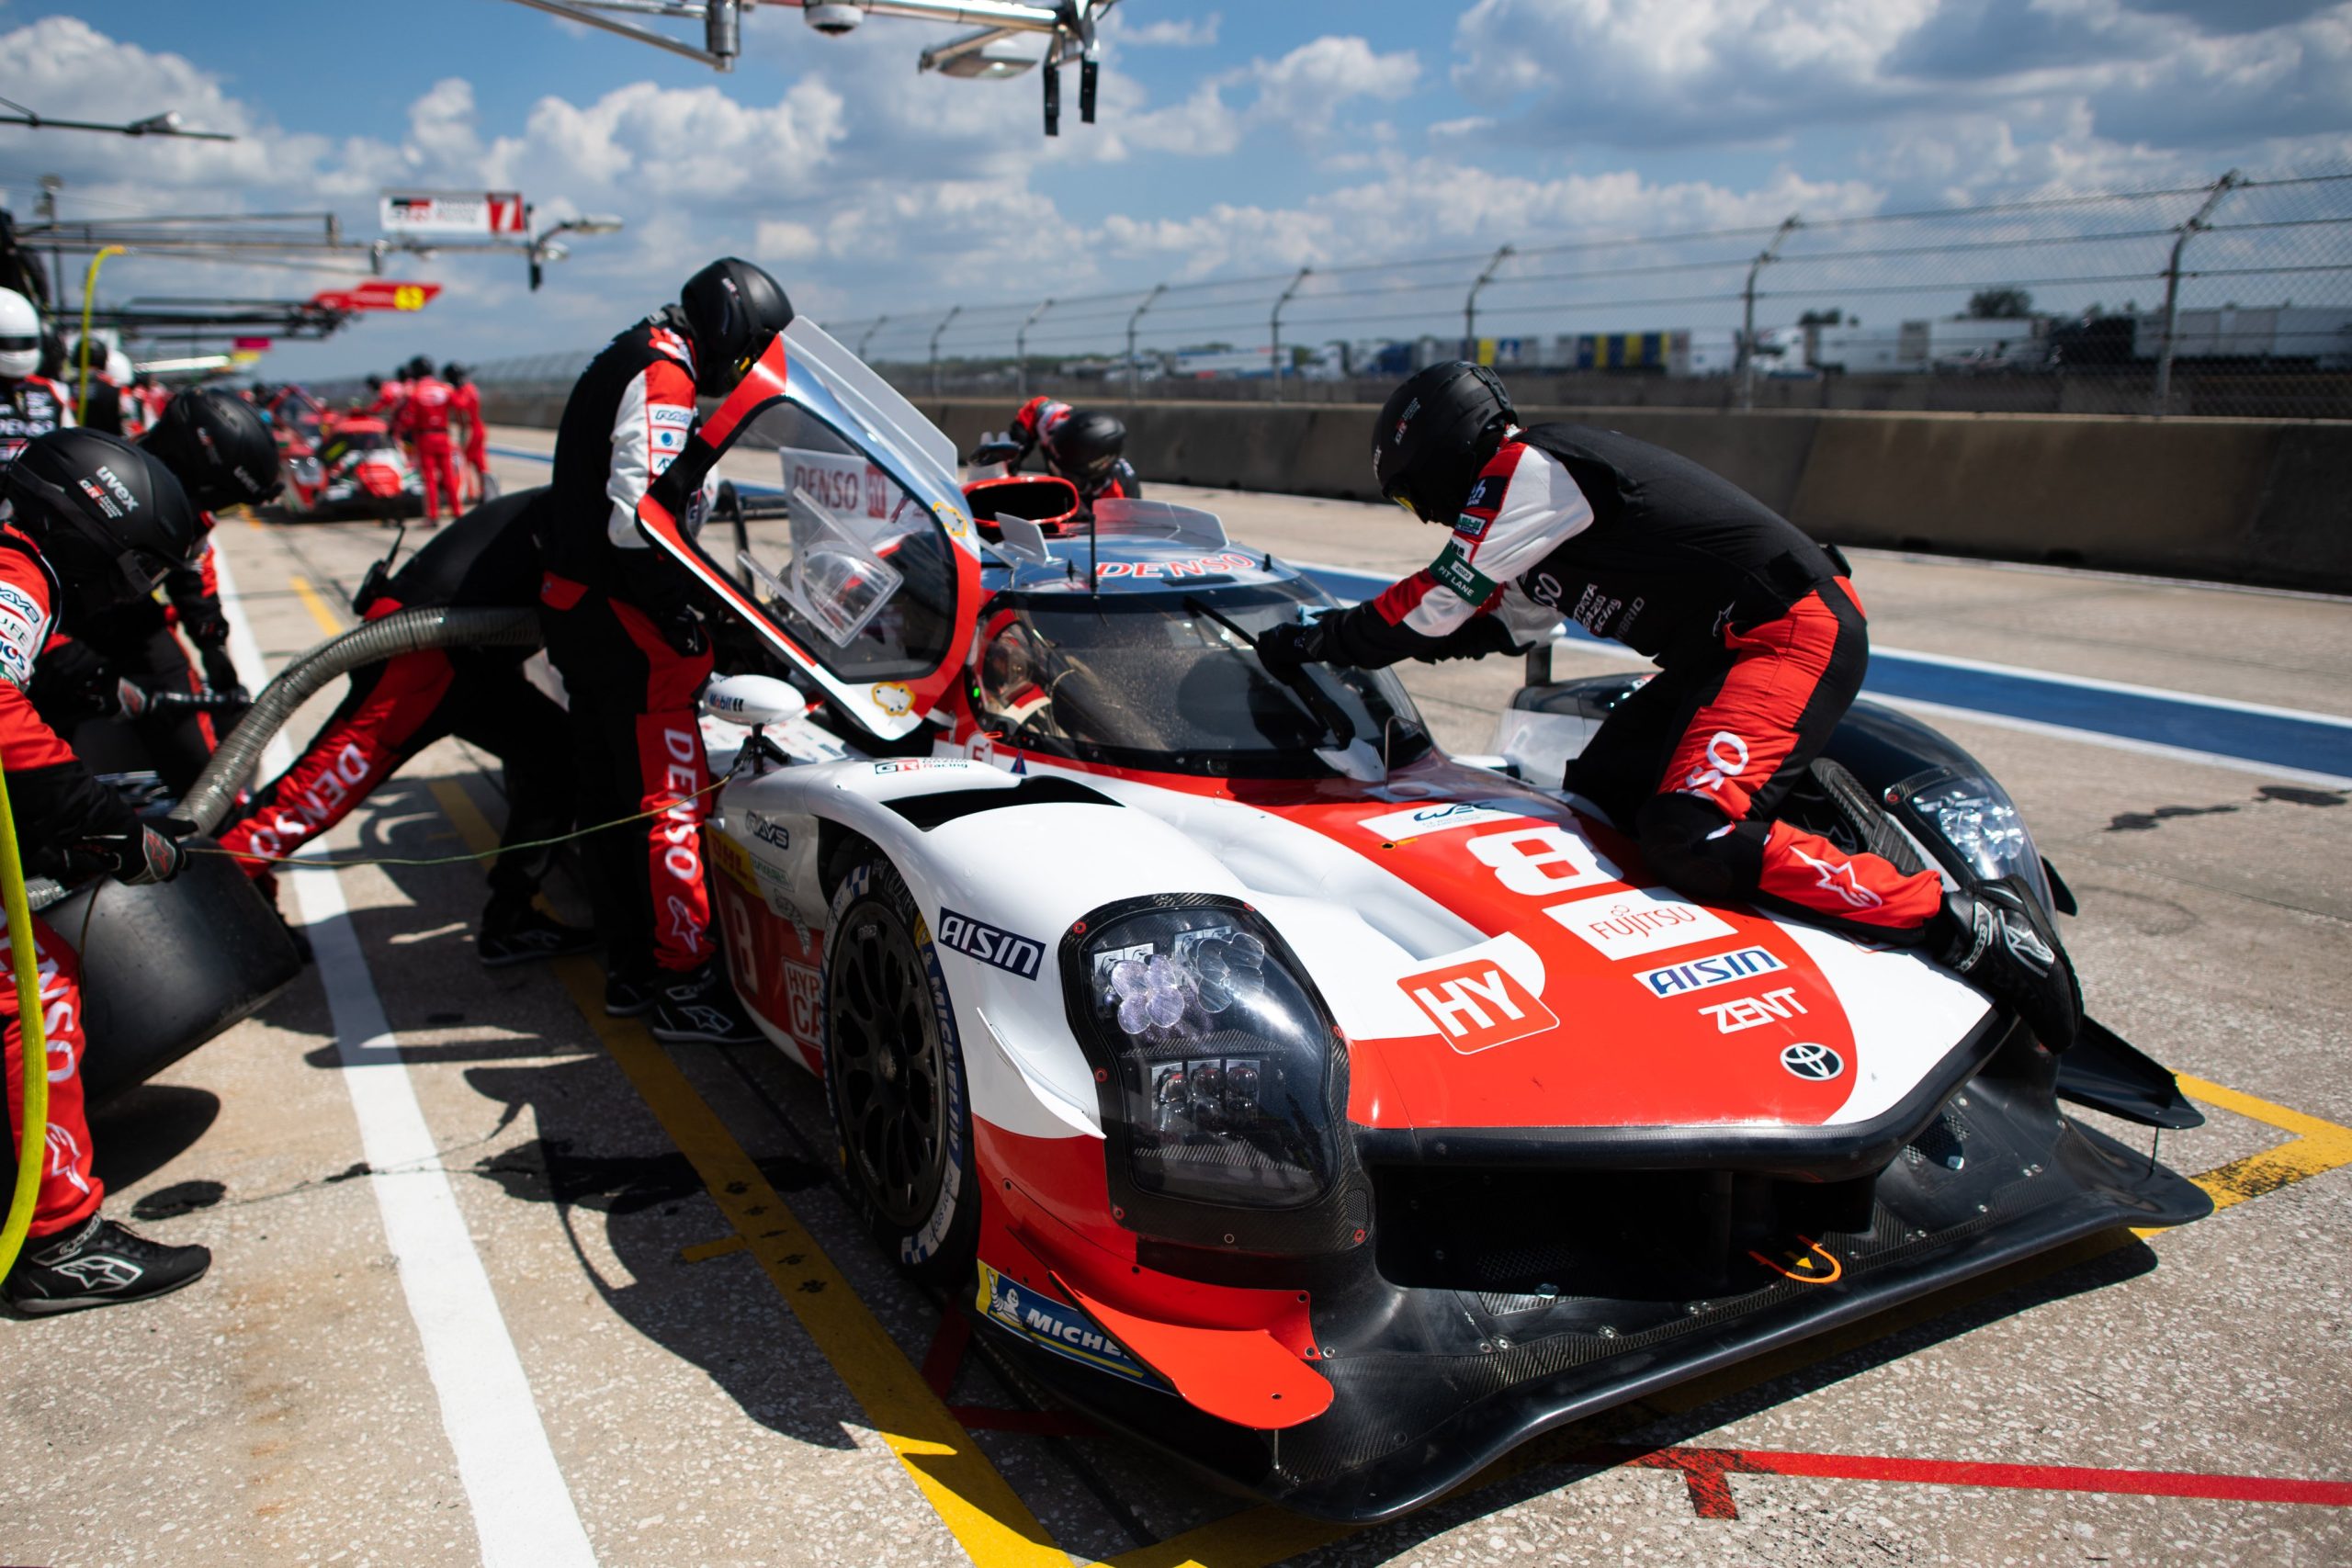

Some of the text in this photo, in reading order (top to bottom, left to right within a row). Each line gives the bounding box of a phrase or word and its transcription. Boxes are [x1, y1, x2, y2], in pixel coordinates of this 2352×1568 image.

[96, 466, 140, 512] uvex
[1096, 552, 1256, 578] DENSO
[1439, 566, 1475, 596] PIT LANE
[1592, 599, 1622, 634] acing
[250, 743, 369, 858] DENSO
[664, 728, 698, 879] DENSO
[744, 810, 789, 850] RAYS
[1466, 826, 1624, 897] 8
[940, 916, 1039, 975] AISIN
[1589, 905, 1697, 941] FUJITSU
[1649, 950, 1778, 995] AISIN
[1413, 970, 1525, 1037] HY
[1698, 987, 1808, 1034] ZENT
[1026, 1308, 1131, 1359] MICHE
